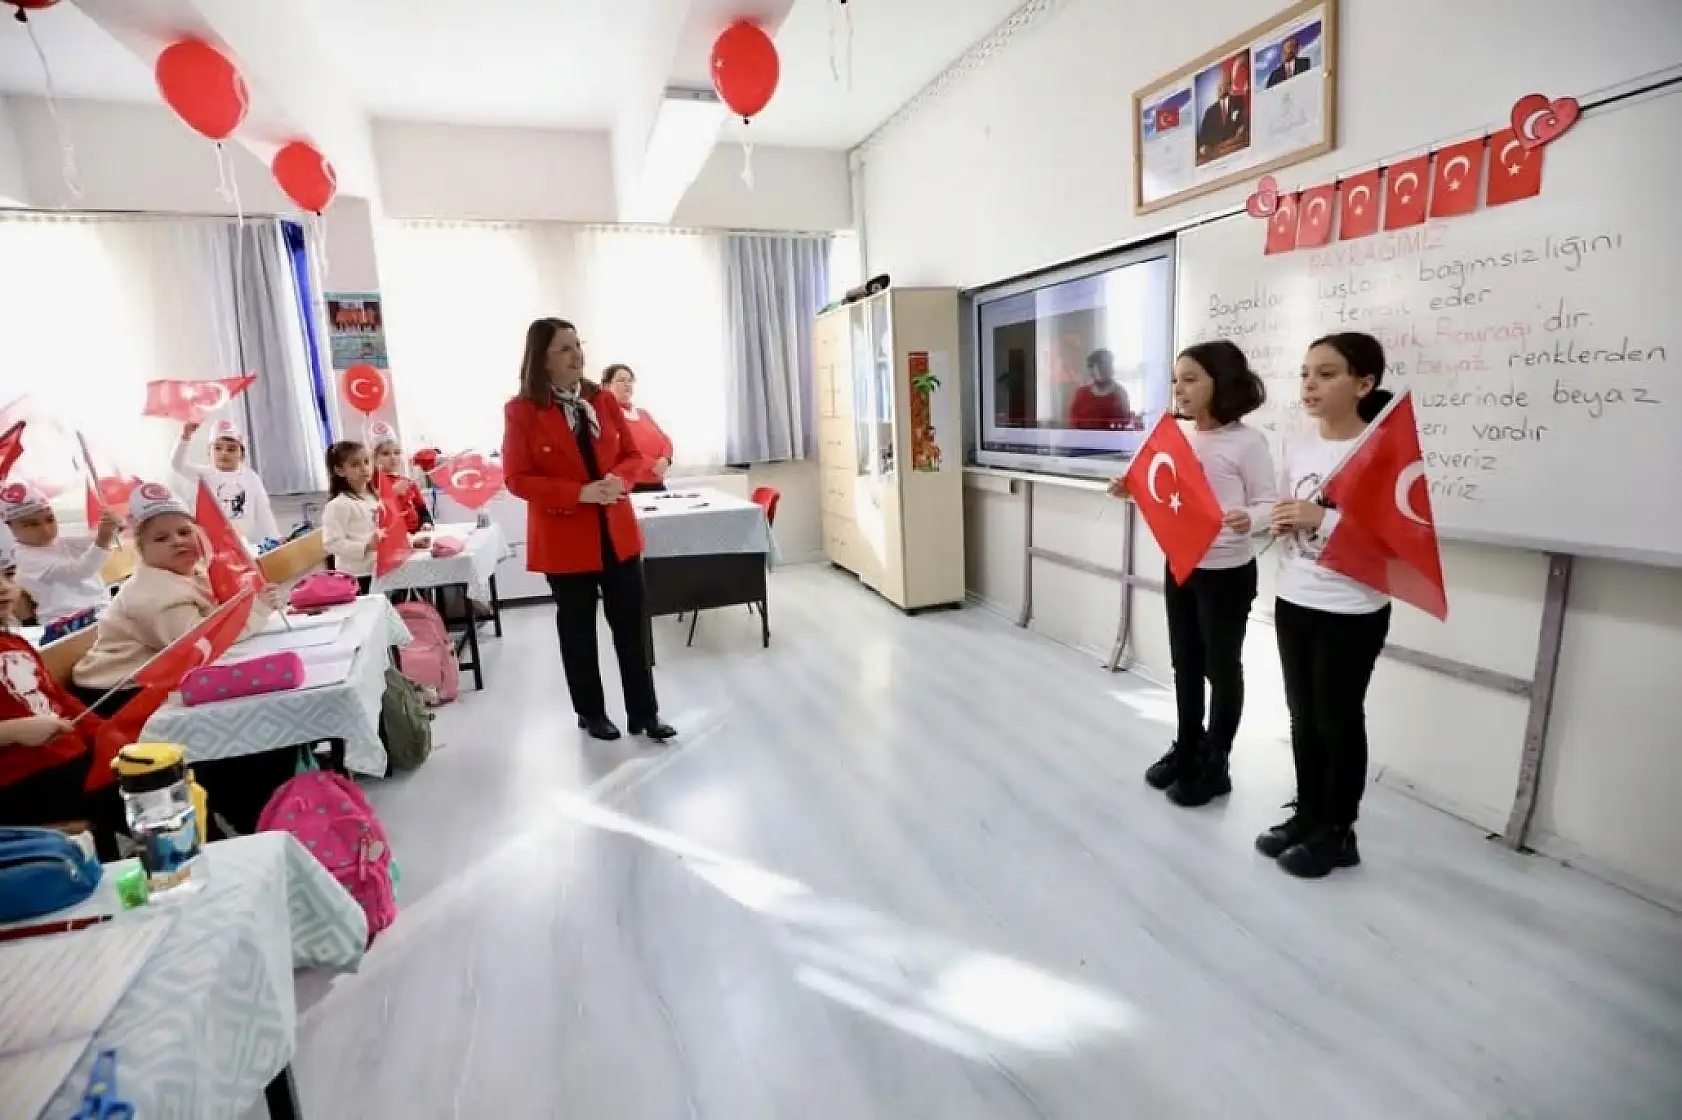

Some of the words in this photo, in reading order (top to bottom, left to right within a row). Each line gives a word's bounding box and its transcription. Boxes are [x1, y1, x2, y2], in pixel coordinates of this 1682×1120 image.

[1428, 287, 1492, 310] eder
[1507, 336, 1667, 369] renklerden
[1552, 378, 1664, 418] beyaz
[1472, 415, 1549, 442] vardır
[1426, 448, 1498, 471] everiz
